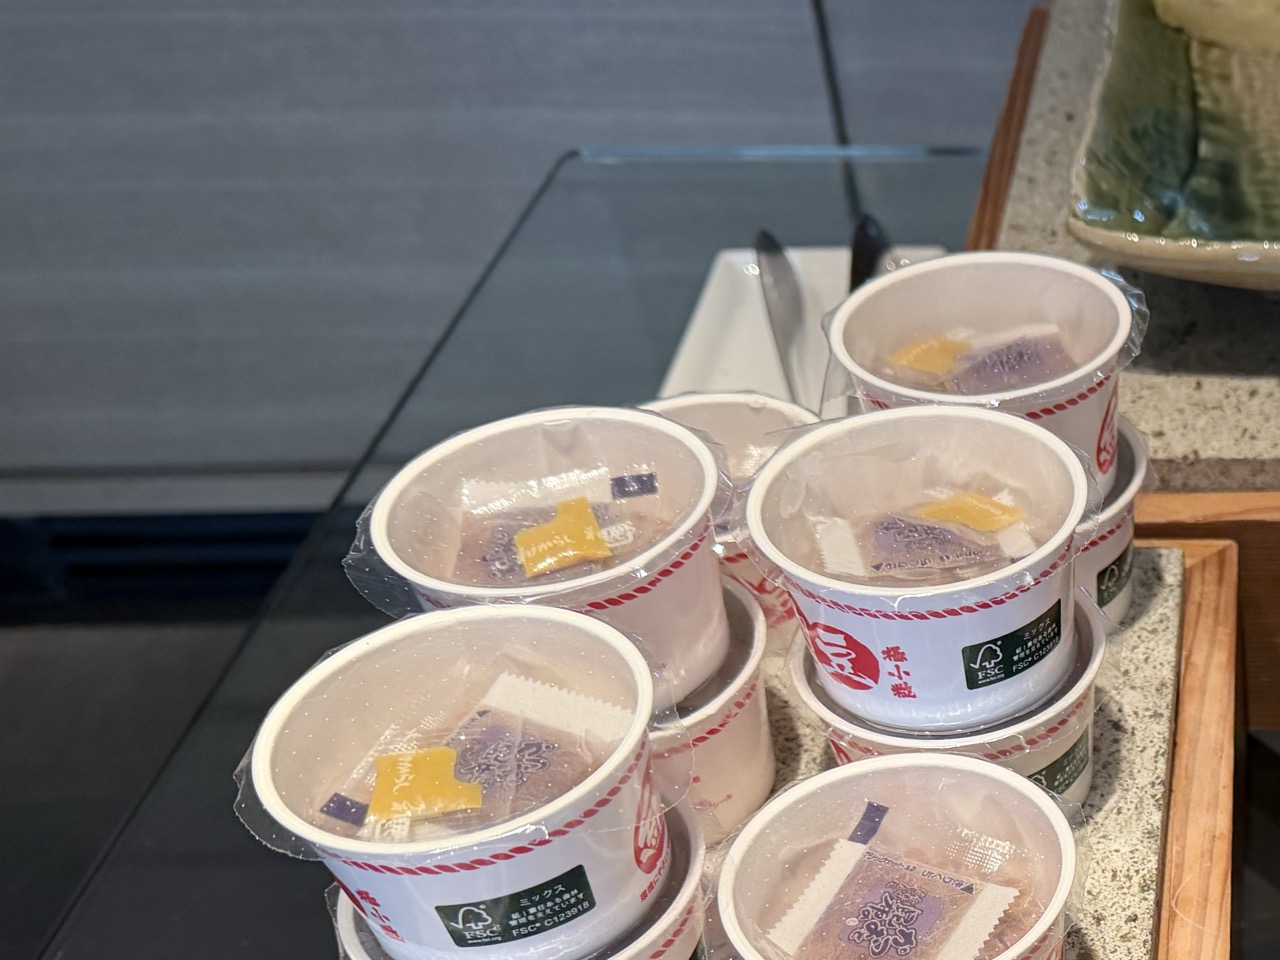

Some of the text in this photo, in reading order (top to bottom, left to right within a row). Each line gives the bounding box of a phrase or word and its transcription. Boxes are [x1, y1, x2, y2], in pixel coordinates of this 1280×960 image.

[881, 645, 918, 699] 極小粒
[977, 664, 1004, 680] FSC
[519, 884, 566, 907] ミックス
[544, 901, 591, 927] C123918
[464, 927, 501, 940] FSC
